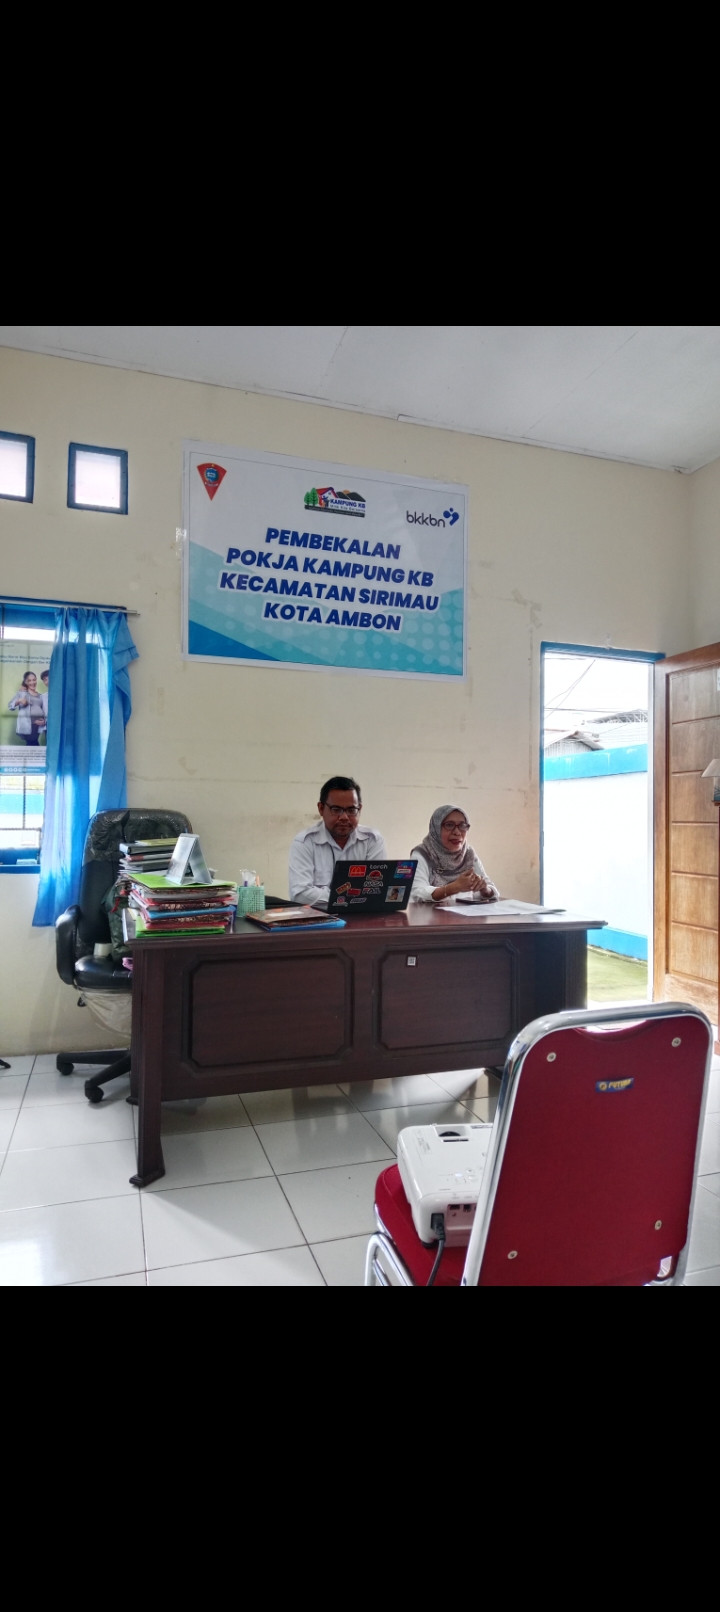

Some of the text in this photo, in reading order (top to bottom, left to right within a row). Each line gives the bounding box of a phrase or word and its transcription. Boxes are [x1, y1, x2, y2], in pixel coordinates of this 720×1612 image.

[406, 510, 445, 528] bkkbn
[265, 527, 401, 560] PEMBEKALAN
[226, 548, 434, 587] POKJA KAMPUNG KB
[220, 573, 439, 611] KECAMATAN SIRIMAU
[264, 603, 402, 630] KOTA AMBON
